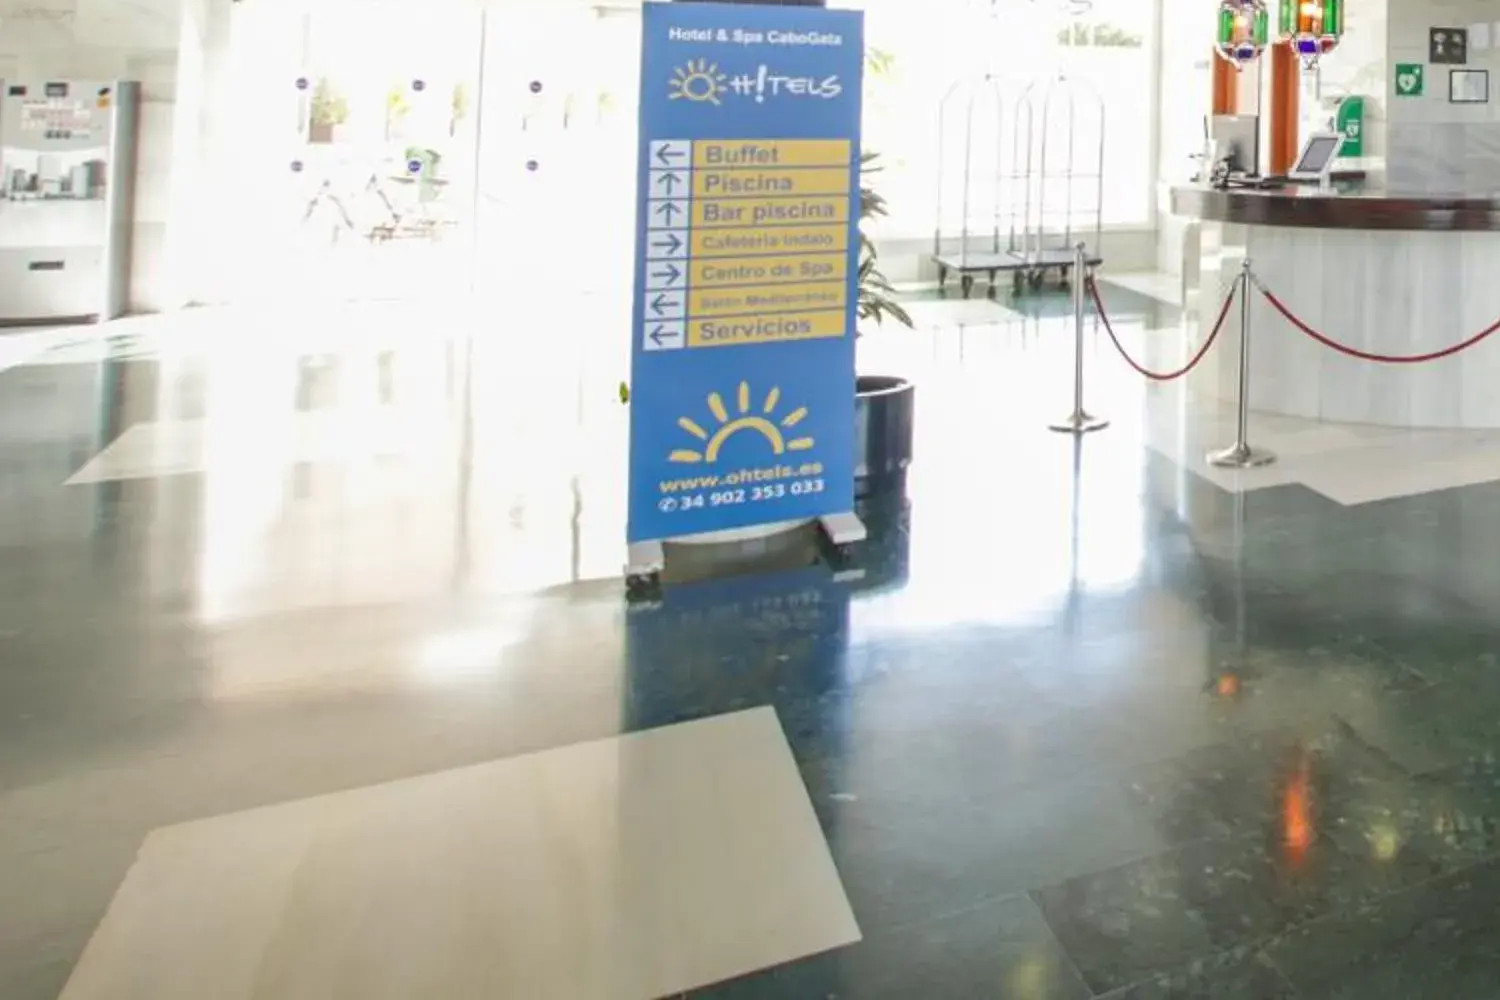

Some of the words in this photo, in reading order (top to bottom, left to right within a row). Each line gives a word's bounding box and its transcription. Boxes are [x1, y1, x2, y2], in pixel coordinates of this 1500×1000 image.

[668, 27, 711, 42] Hotel
[716, 28, 728, 42] &
[733, 29, 763, 46] Spa
[705, 145, 779, 164] Buffet
[704, 173, 793, 192] Piscina
[703, 203, 745, 222] Bar
[753, 201, 835, 226] piscina
[702, 263, 766, 280] Centro
[770, 263, 792, 277] de
[800, 261, 833, 278] Spa
[700, 319, 812, 341] Servicios
[658, 461, 824, 493] www.ohtels.es
[710, 489, 745, 507] 902
[791, 478, 825, 496] 033
